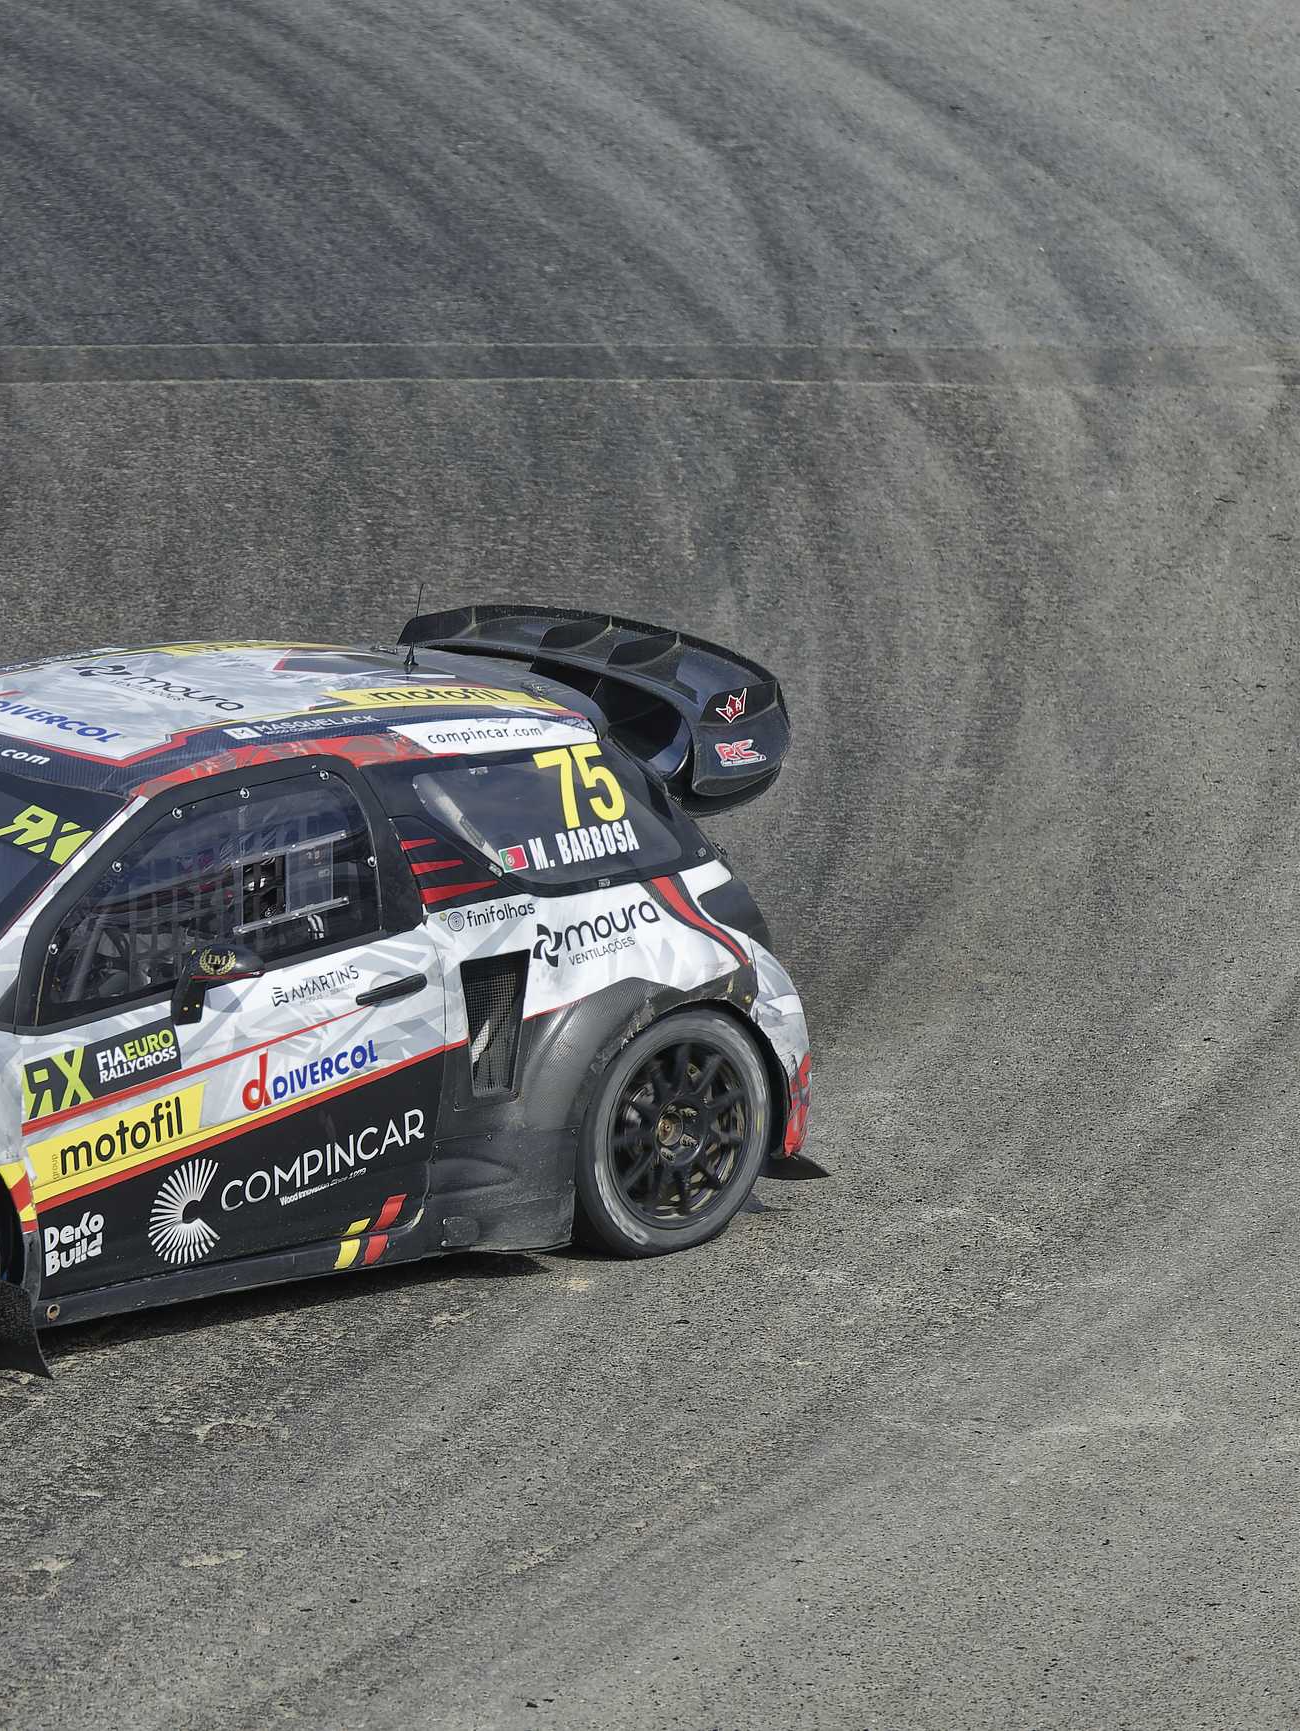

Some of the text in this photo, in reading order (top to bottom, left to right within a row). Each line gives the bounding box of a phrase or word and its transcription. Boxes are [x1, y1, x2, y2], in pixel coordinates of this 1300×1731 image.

[123, 676, 245, 711] moura
[252, 714, 381, 733] MASQUELACK
[426, 725, 543, 747] compincar.com
[533, 743, 627, 829] 75
[527, 819, 641, 871] M. BARBOSA
[466, 902, 536, 928] finifolhas
[564, 900, 661, 952] moura
[567, 936, 636, 966] VENTILAÇÕES
[99, 1045, 178, 1084] RALLYCROSS
[272, 1038, 379, 1101] DIVERCOL
[60, 1095, 184, 1177] motofil
[220, 1107, 426, 1213] COMPINCAR
[44, 1231, 103, 1278] Build
